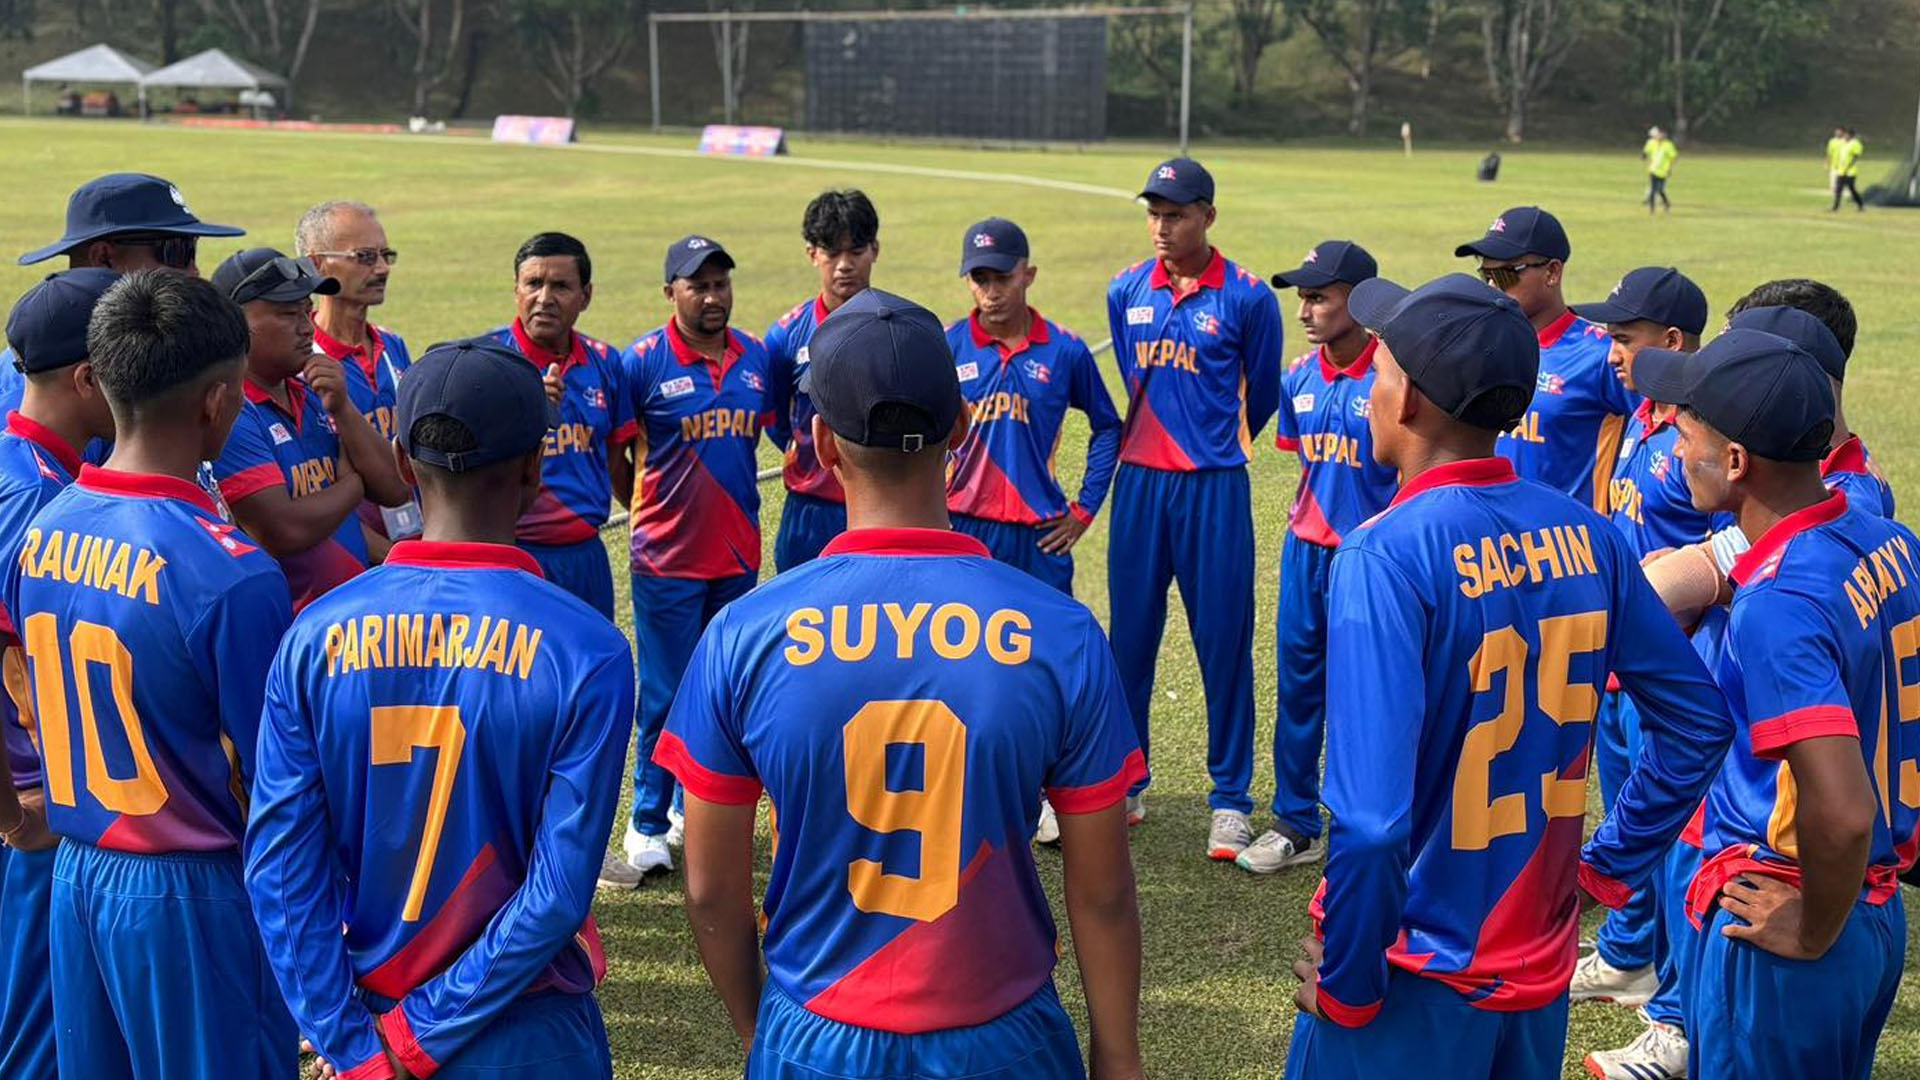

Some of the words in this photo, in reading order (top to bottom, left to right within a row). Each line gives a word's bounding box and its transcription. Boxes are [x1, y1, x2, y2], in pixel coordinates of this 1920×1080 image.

[1135, 338, 1200, 374] NEPAL
[20, 528, 167, 605] RAUNAK
[1453, 524, 1598, 599] SACHIN
[325, 613, 543, 680] PARIMARJAN
[784, 602, 1032, 665] SUYOG
[25, 612, 169, 815] 10
[1451, 610, 1608, 850] 25
[370, 705, 466, 921] 7
[842, 699, 966, 923] 9
